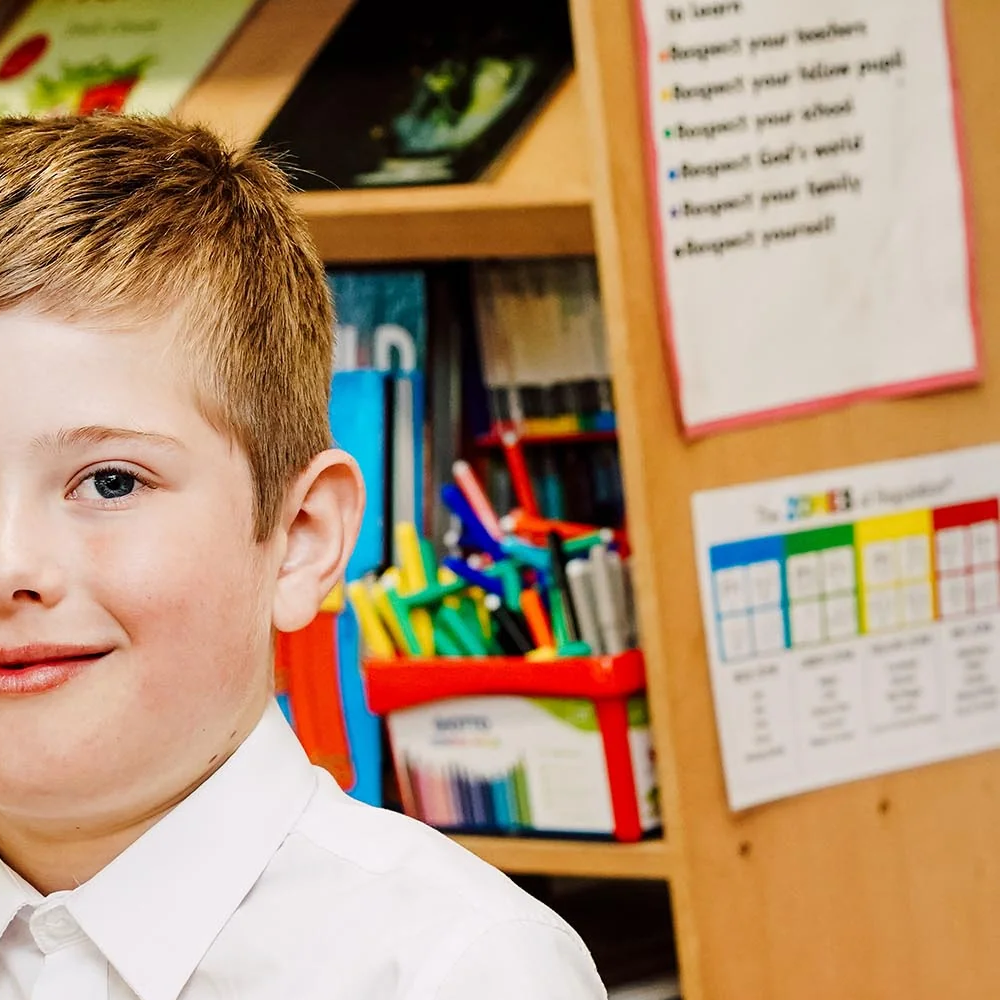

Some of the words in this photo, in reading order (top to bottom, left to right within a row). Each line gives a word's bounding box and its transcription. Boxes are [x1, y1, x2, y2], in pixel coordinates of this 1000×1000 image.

[671, 37, 741, 63] Respect
[750, 34, 787, 57] your
[797, 20, 868, 43] teachers
[674, 76, 744, 102] Respect
[752, 73, 791, 95] your
[677, 116, 747, 142] Respect
[756, 111, 794, 134] your
[802, 94, 856, 121] school
[681, 153, 751, 180] Respect
[815, 134, 863, 157] world
[684, 194, 754, 219] Respect
[761, 188, 798, 211] your
[808, 175, 861, 198] family
[686, 231, 755, 256] Respect
[763, 215, 836, 247] yourself
